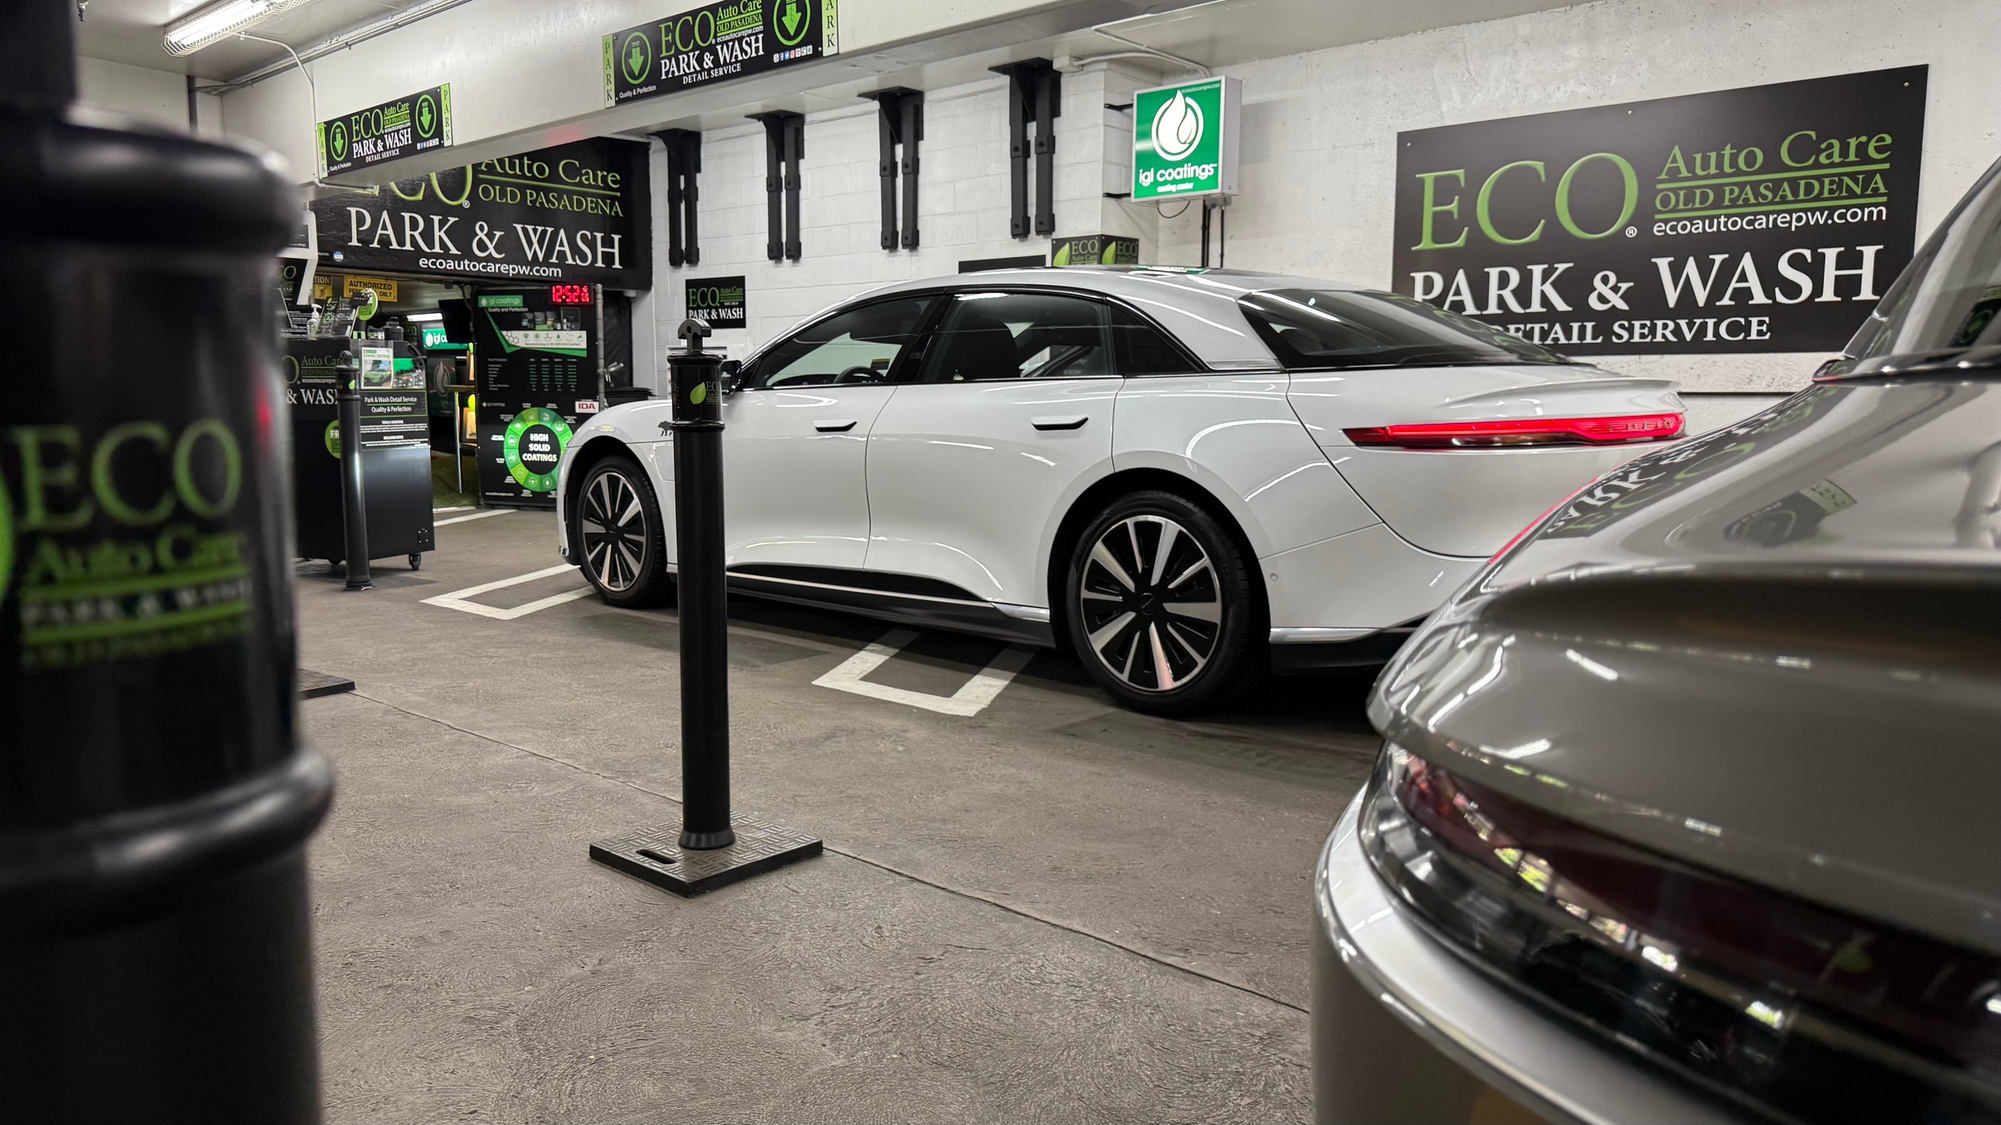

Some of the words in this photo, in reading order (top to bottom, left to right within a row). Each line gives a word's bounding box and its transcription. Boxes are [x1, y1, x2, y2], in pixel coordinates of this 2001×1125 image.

[716, 5, 739, 21] Auto
[740, 0, 762, 13] Care
[717, 22, 731, 33] OLD
[731, 14, 763, 31] PASADENA
[826, 0, 835, 48] ARK
[660, 51, 701, 79] PARK
[703, 53, 714, 69] &
[716, 34, 764, 65] WASH
[605, 42, 613, 102] PARK
[683, 71, 709, 85] DETAIL
[711, 63, 742, 79] SERVICE
[619, 90, 632, 99] Quality
[637, 85, 657, 94] Perfection
[353, 138, 376, 158] PARK
[377, 139, 384, 152] &
[384, 128, 412, 150] WASH
[365, 153, 381, 163] DETAIL
[381, 148, 399, 158] SERVICE
[1657, 144, 1764, 179] Auto
[1780, 130, 1892, 167] Care
[559, 159, 620, 188] Care
[1139, 167, 1154, 187] igl
[479, 184, 521, 204] OLD
[526, 189, 624, 217] PASADENA
[1655, 186, 1713, 211] OLD
[1720, 172, 1888, 208] PASADENA
[1653, 205, 1887, 236] ecoautocarepw.com
[347, 207, 462, 255] PARK
[472, 221, 505, 259] &
[513, 223, 623, 269] WASH
[419, 257, 562, 278] ecoautocarepw.com
[349, 280, 392, 291] AUTHORIZED
[1410, 262, 1574, 316] PARK
[1588, 270, 1634, 311] &
[1651, 245, 1885, 308] WASH
[688, 309, 709, 320] PARK
[711, 309, 717, 319] &
[719, 307, 743, 319] WASH
[1612, 316, 1770, 344] SERVICE
[301, 355, 322, 366] Auto
[286, 389, 298, 404] &
[528, 443, 551, 452] SOLID
[530, 433, 549, 442] HIGH
[522, 453, 557, 462] COATINGS
[11, 418, 242, 533] ECO
